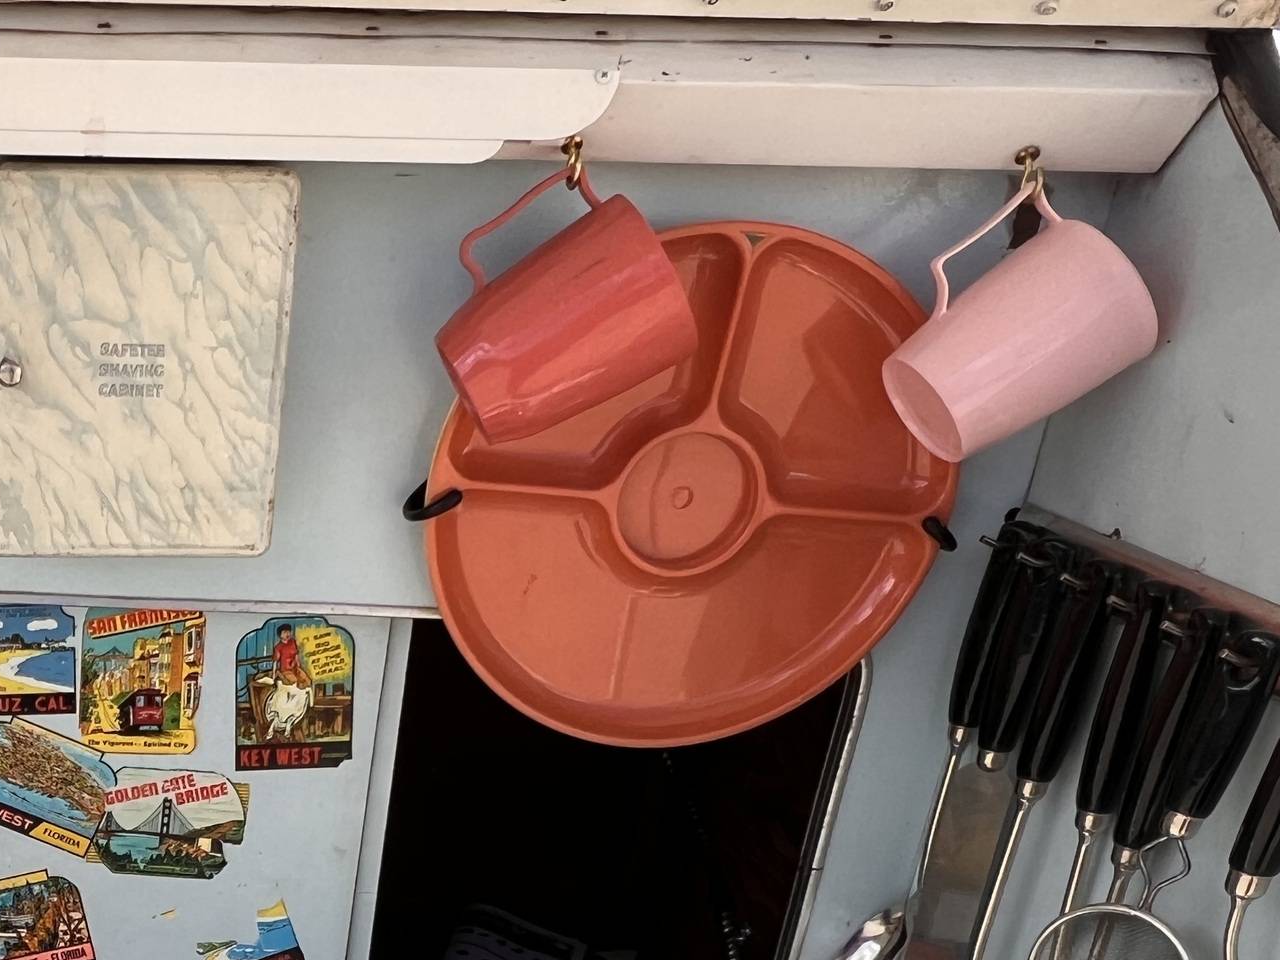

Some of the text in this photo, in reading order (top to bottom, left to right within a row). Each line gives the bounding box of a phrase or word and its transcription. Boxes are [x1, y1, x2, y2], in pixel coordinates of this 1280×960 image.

[100, 342, 165, 358] SAFETEE
[99, 363, 165, 378] SHAVING
[98, 383, 164, 398] CABINET
[87, 616, 117, 636] SAN
[239, 746, 322, 767] KEY WEST
[104, 773, 196, 806] GOLDEN GATE
[174, 782, 229, 806] BRIDGE
[42, 827, 81, 849] FLORIDA
